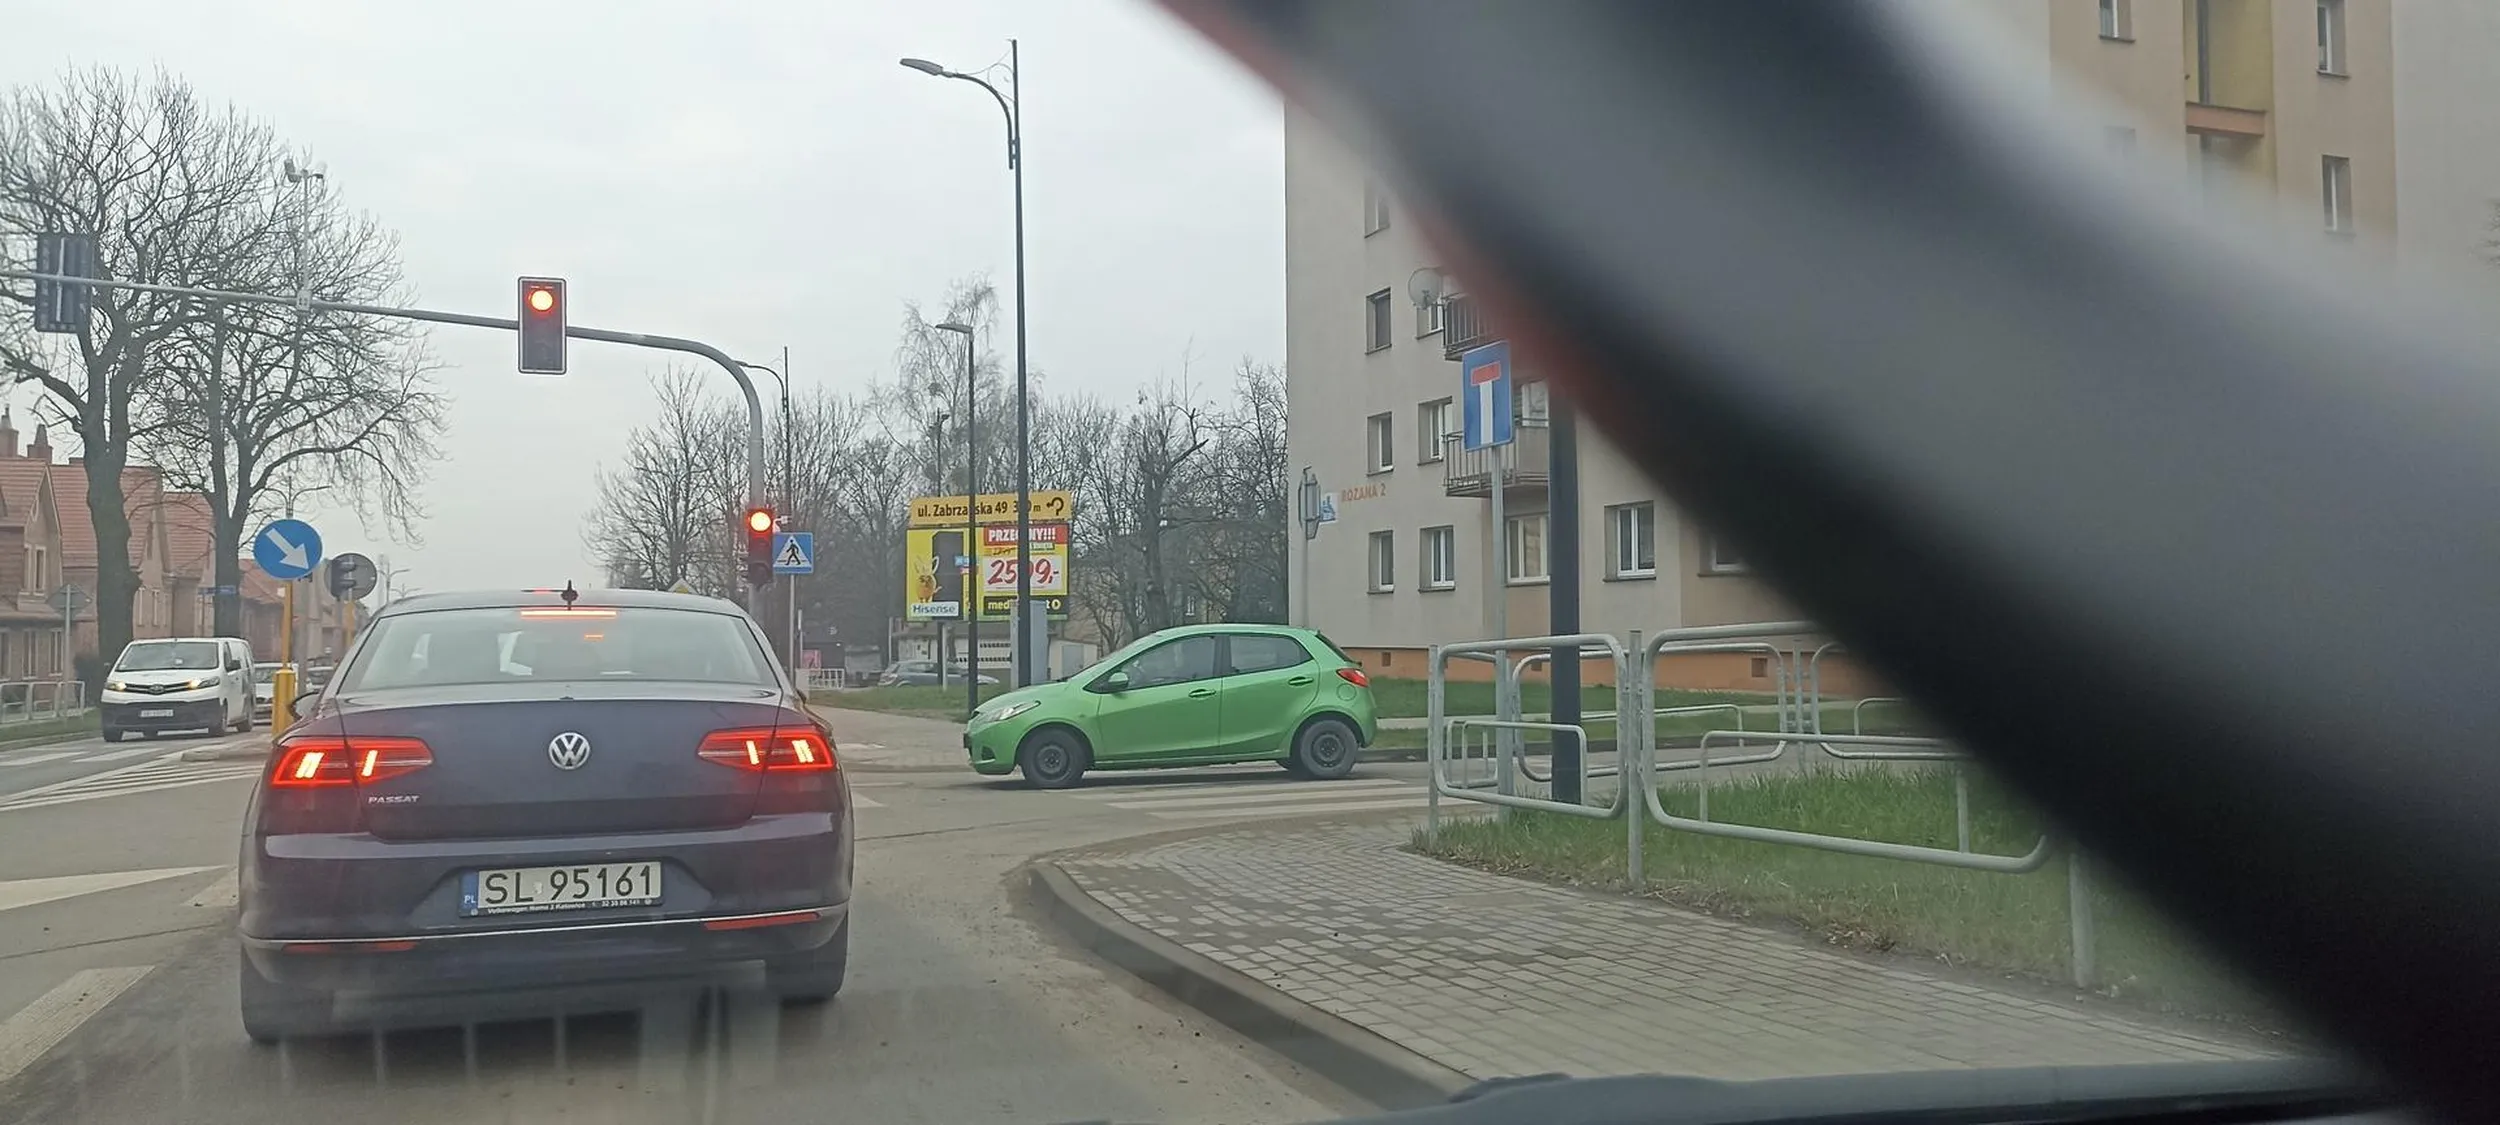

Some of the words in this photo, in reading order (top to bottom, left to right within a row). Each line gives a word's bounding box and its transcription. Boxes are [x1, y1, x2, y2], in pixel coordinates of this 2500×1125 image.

[917, 506, 931, 517] ul.
[933, 502, 993, 517] Zabrzaska
[995, 501, 1008, 514] 49
[1033, 504, 1041, 512] m
[988, 558, 1060, 585] 259,-
[912, 605, 956, 614] Hisense
[368, 795, 420, 804] PASSAT
[485, 871, 534, 905] SL
[550, 865, 651, 901] 95161
[464, 895, 476, 904] PL
